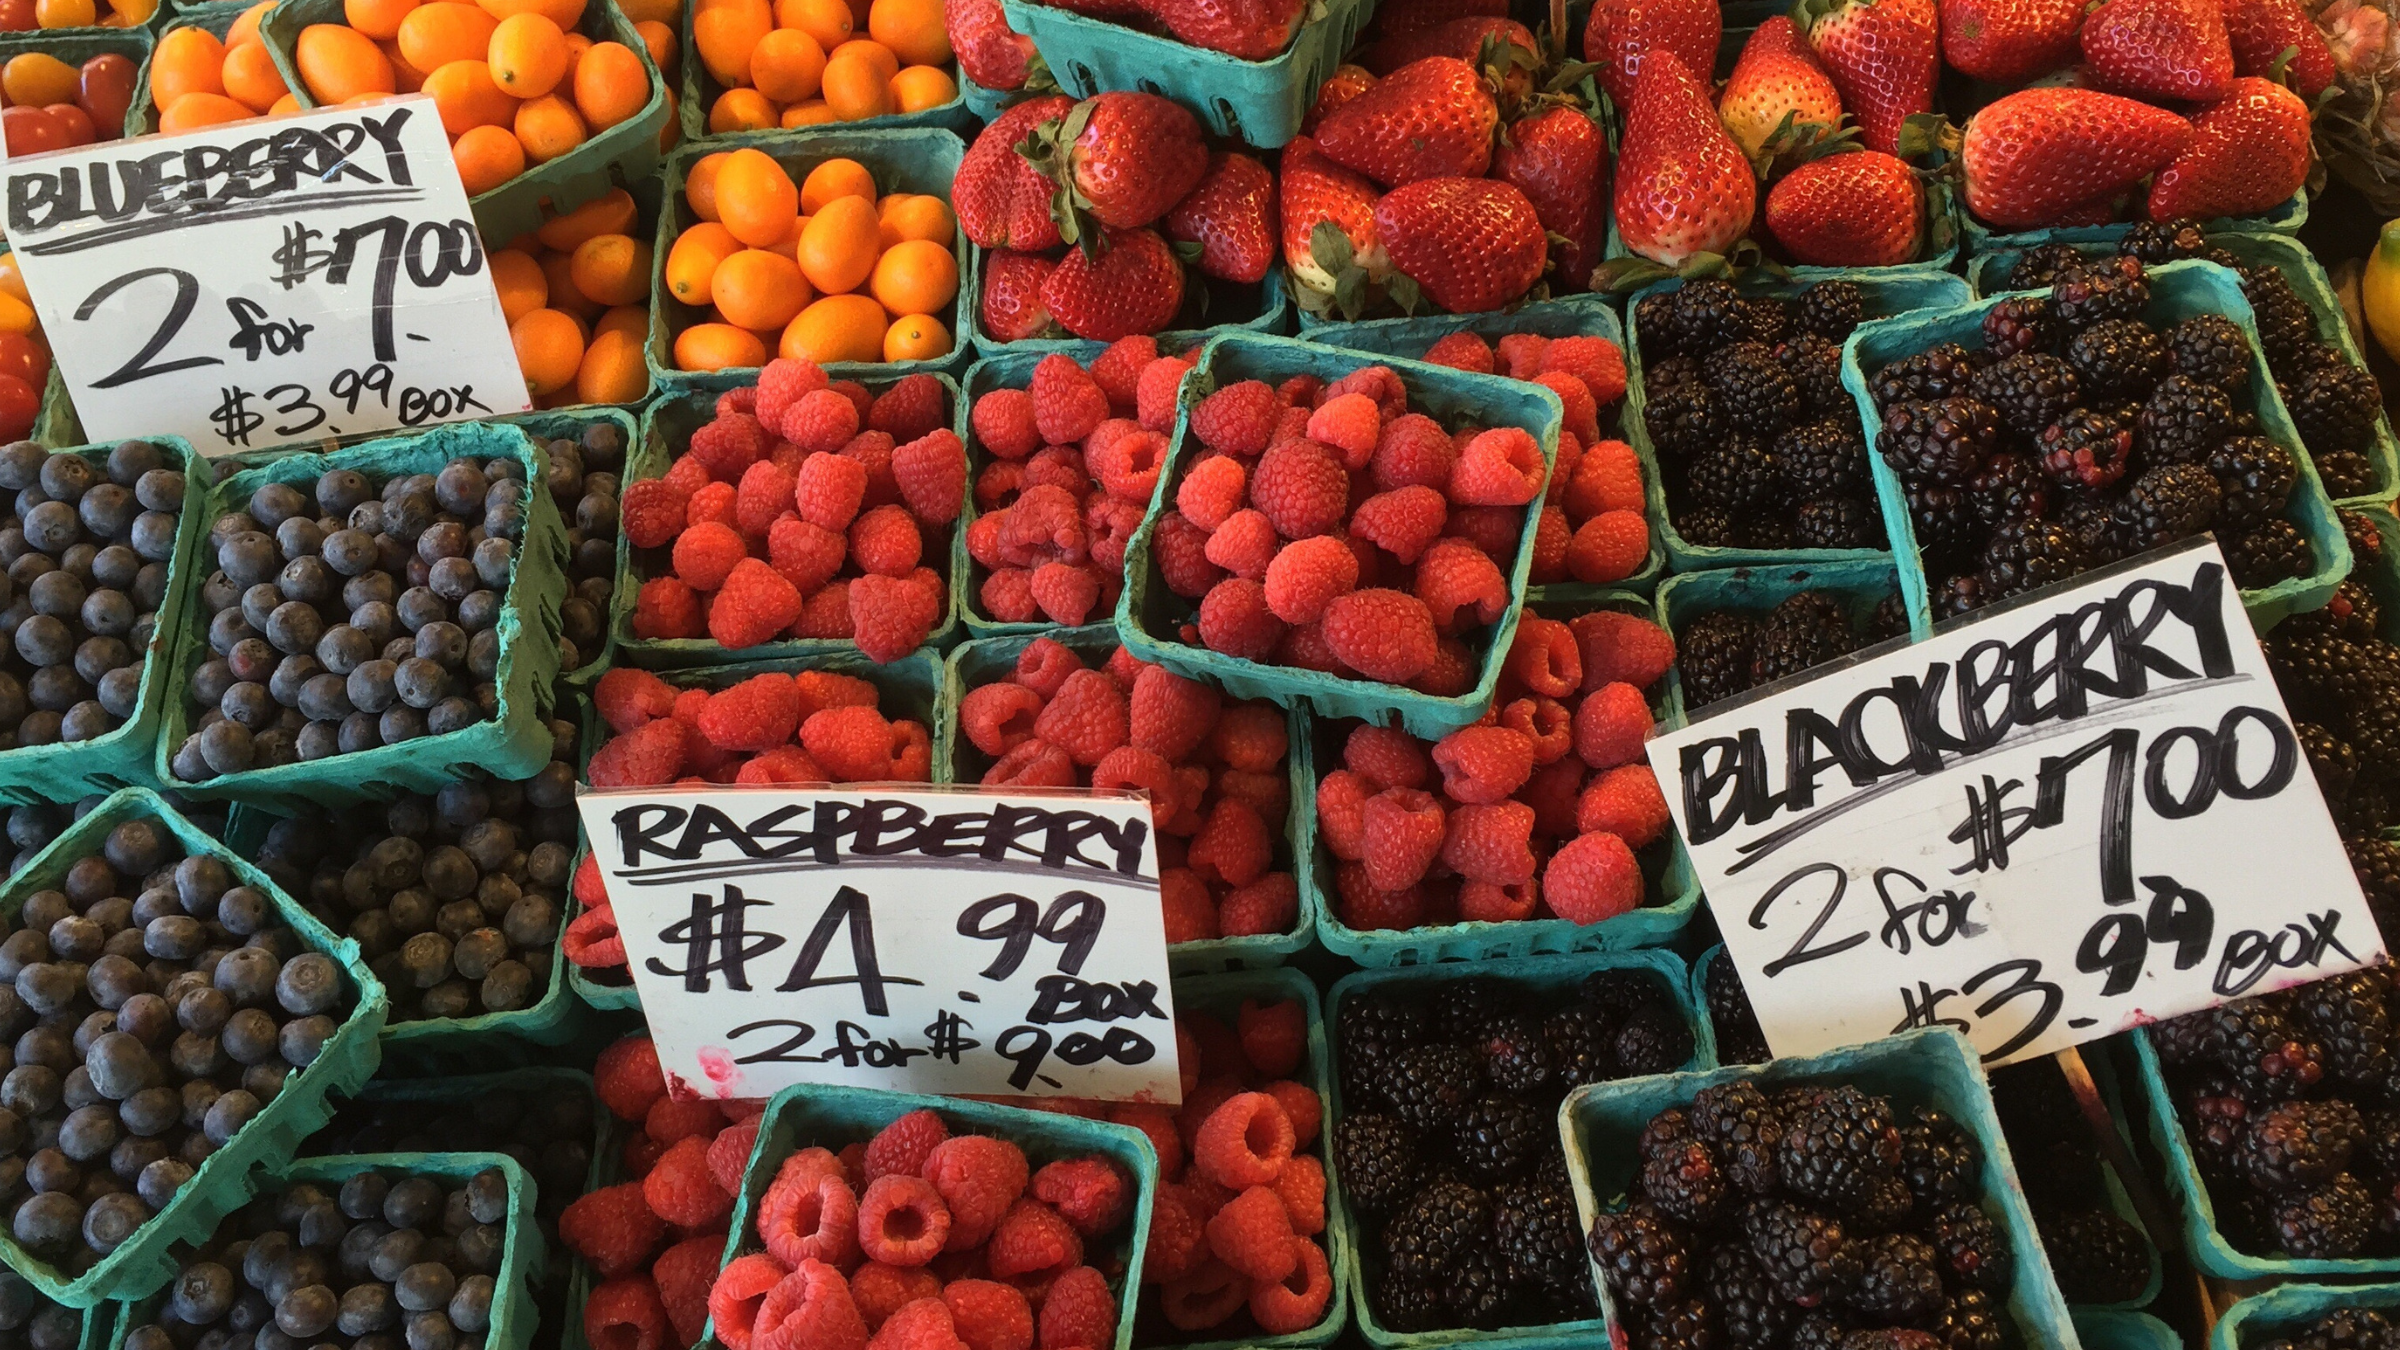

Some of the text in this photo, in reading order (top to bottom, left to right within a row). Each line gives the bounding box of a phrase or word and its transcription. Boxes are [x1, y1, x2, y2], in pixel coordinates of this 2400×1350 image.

[7, 107, 414, 233] BLUEBERRY
[73, 266, 225, 389] 2
[226, 296, 315, 362] for
[209, 363, 394, 446] $3.99
[1678, 561, 2236, 846] BLACKBERRY
[612, 799, 1148, 877] RASPBERRY
[645, 884, 1106, 1017] $4.99
[1747, 861, 1871, 978] 2
[1871, 866, 1992, 956] for
[726, 1019, 829, 1065] 2
[822, 1019, 931, 1069] for
